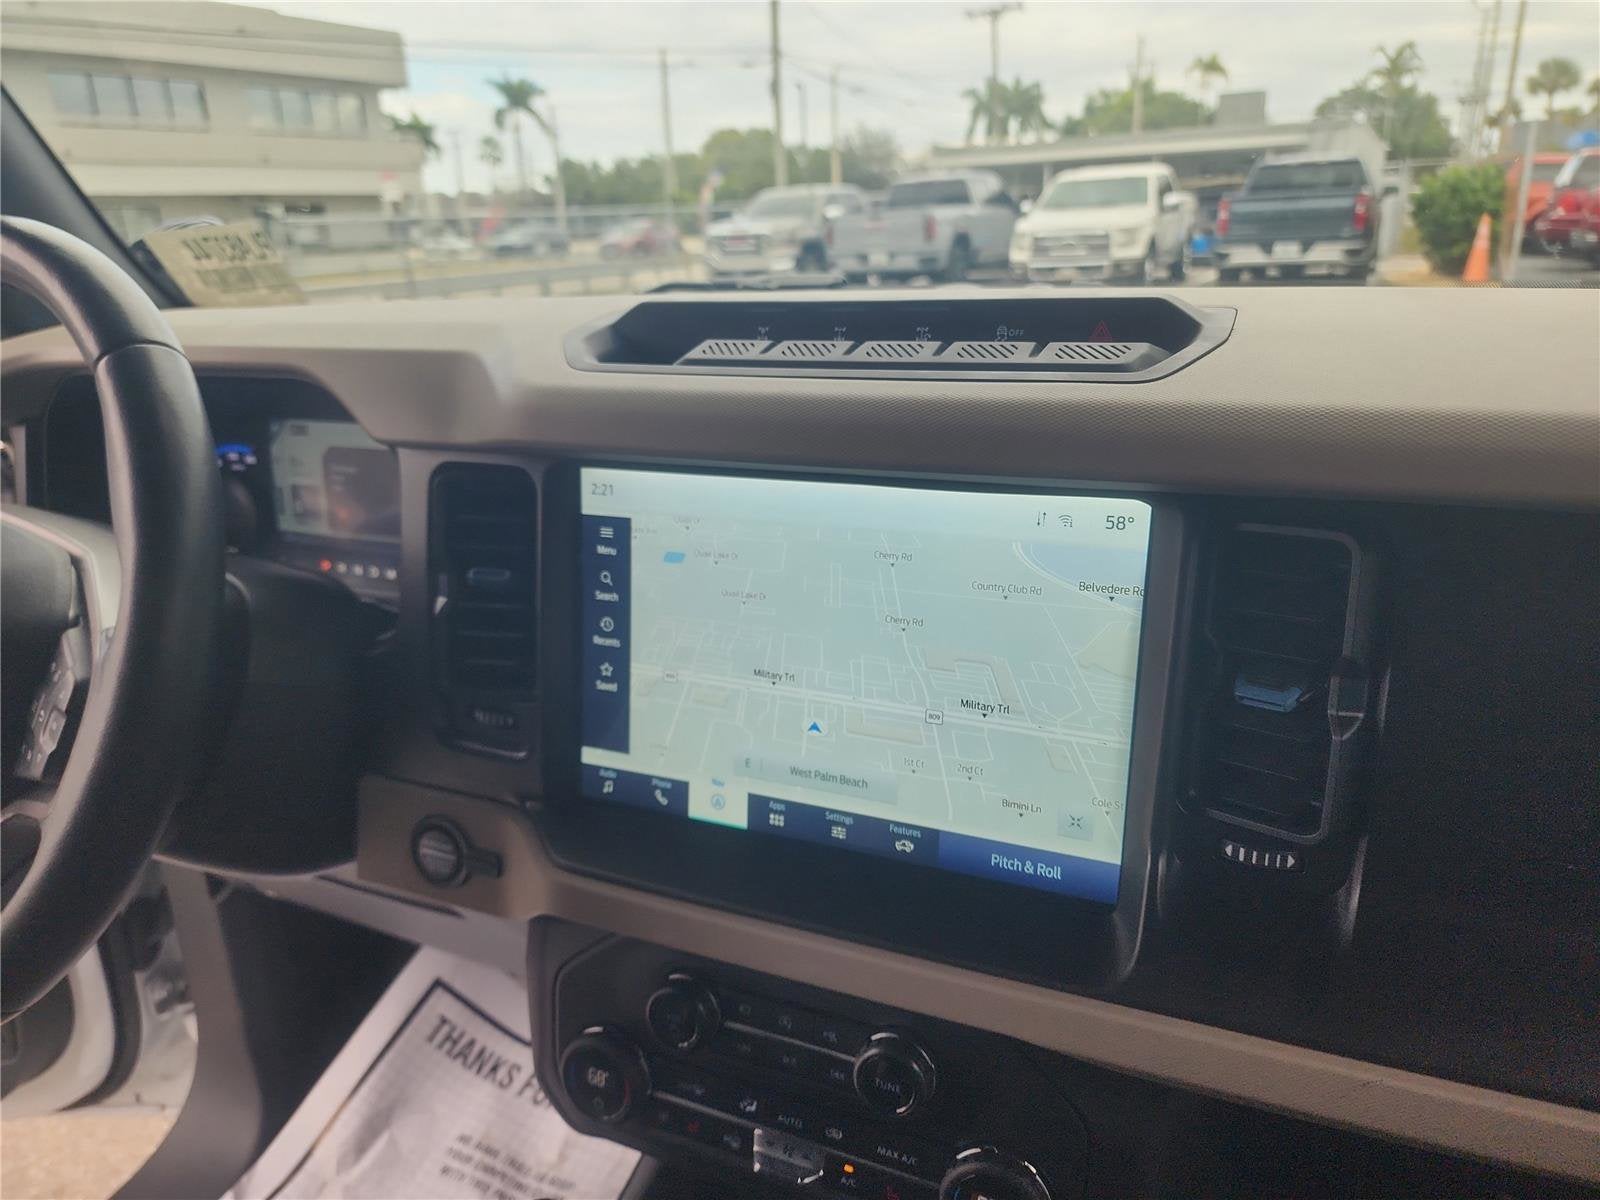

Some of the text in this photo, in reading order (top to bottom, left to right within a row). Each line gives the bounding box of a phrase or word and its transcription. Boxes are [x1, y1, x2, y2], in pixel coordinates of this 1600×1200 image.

[1008, 329, 1024, 337] OFF
[591, 483, 615, 497] 2:21
[1104, 515, 1135, 531] 58°
[596, 544, 617, 556] Menu
[873, 550, 913, 563] Cherry Rd
[971, 580, 1042, 596] Country Club Rd
[1078, 581, 1130, 596] Belvedere
[594, 589, 619, 602] Search
[885, 614, 924, 627] Cherry Rd
[753, 668, 796, 682] Military Trl
[960, 698, 1010, 714] Military Trl
[957, 763, 983, 776] 2nd Ct
[789, 766, 868, 788] West Palm Beach
[768, 801, 786, 812] Apps
[1001, 798, 1042, 813] Bimini Ln
[1091, 797, 1112, 808] Cole
[825, 811, 854, 825] Settings
[889, 824, 921, 838] Features
[990, 853, 1062, 880] Pitch & Roll
[426, 1015, 521, 1089] THANKS
[877, 1146, 899, 1159] MAX
